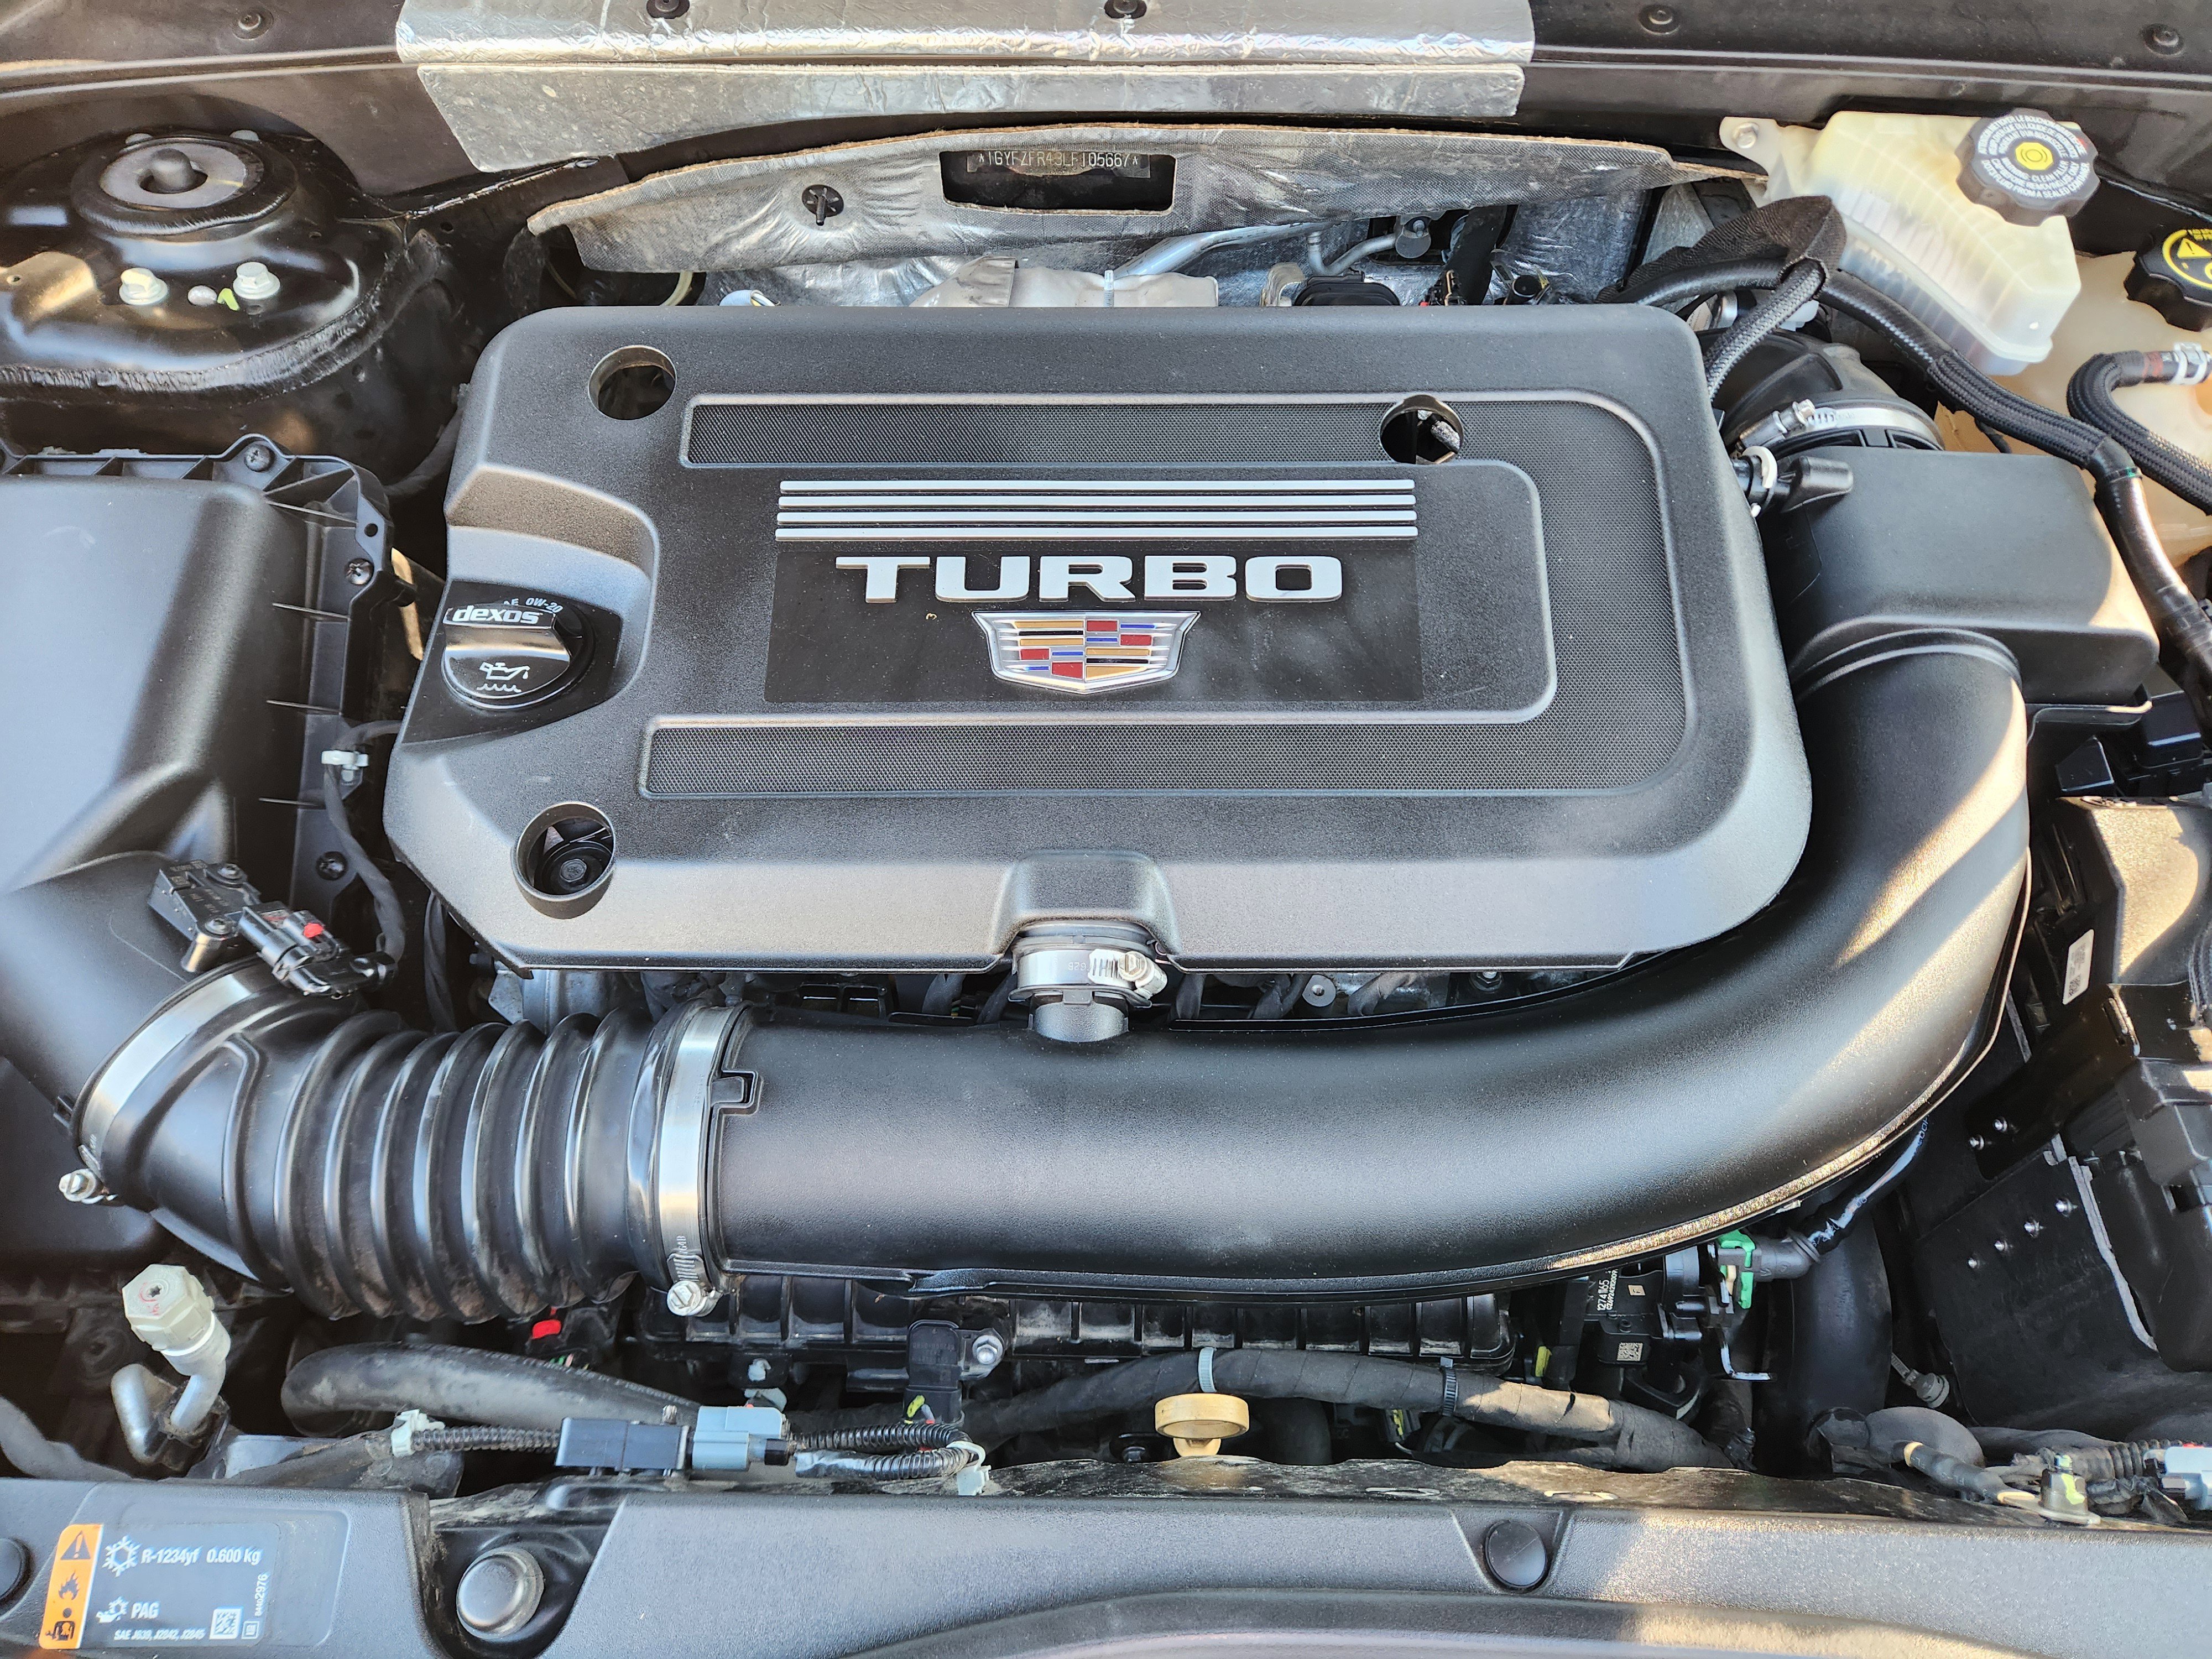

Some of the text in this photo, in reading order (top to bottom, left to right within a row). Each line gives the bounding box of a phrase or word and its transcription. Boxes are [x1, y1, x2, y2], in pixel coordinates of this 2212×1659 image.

[836, 555, 1343, 603] TURBO
[452, 605, 540, 624] dexos
[525, 597, 564, 613] 0W-20
[1597, 1280, 1610, 1311] 12741165
[141, 1547, 262, 1566] R-1234yf 0.600 kg
[131, 1602, 159, 1619] PAG
[114, 1629, 132, 1641] SAE
